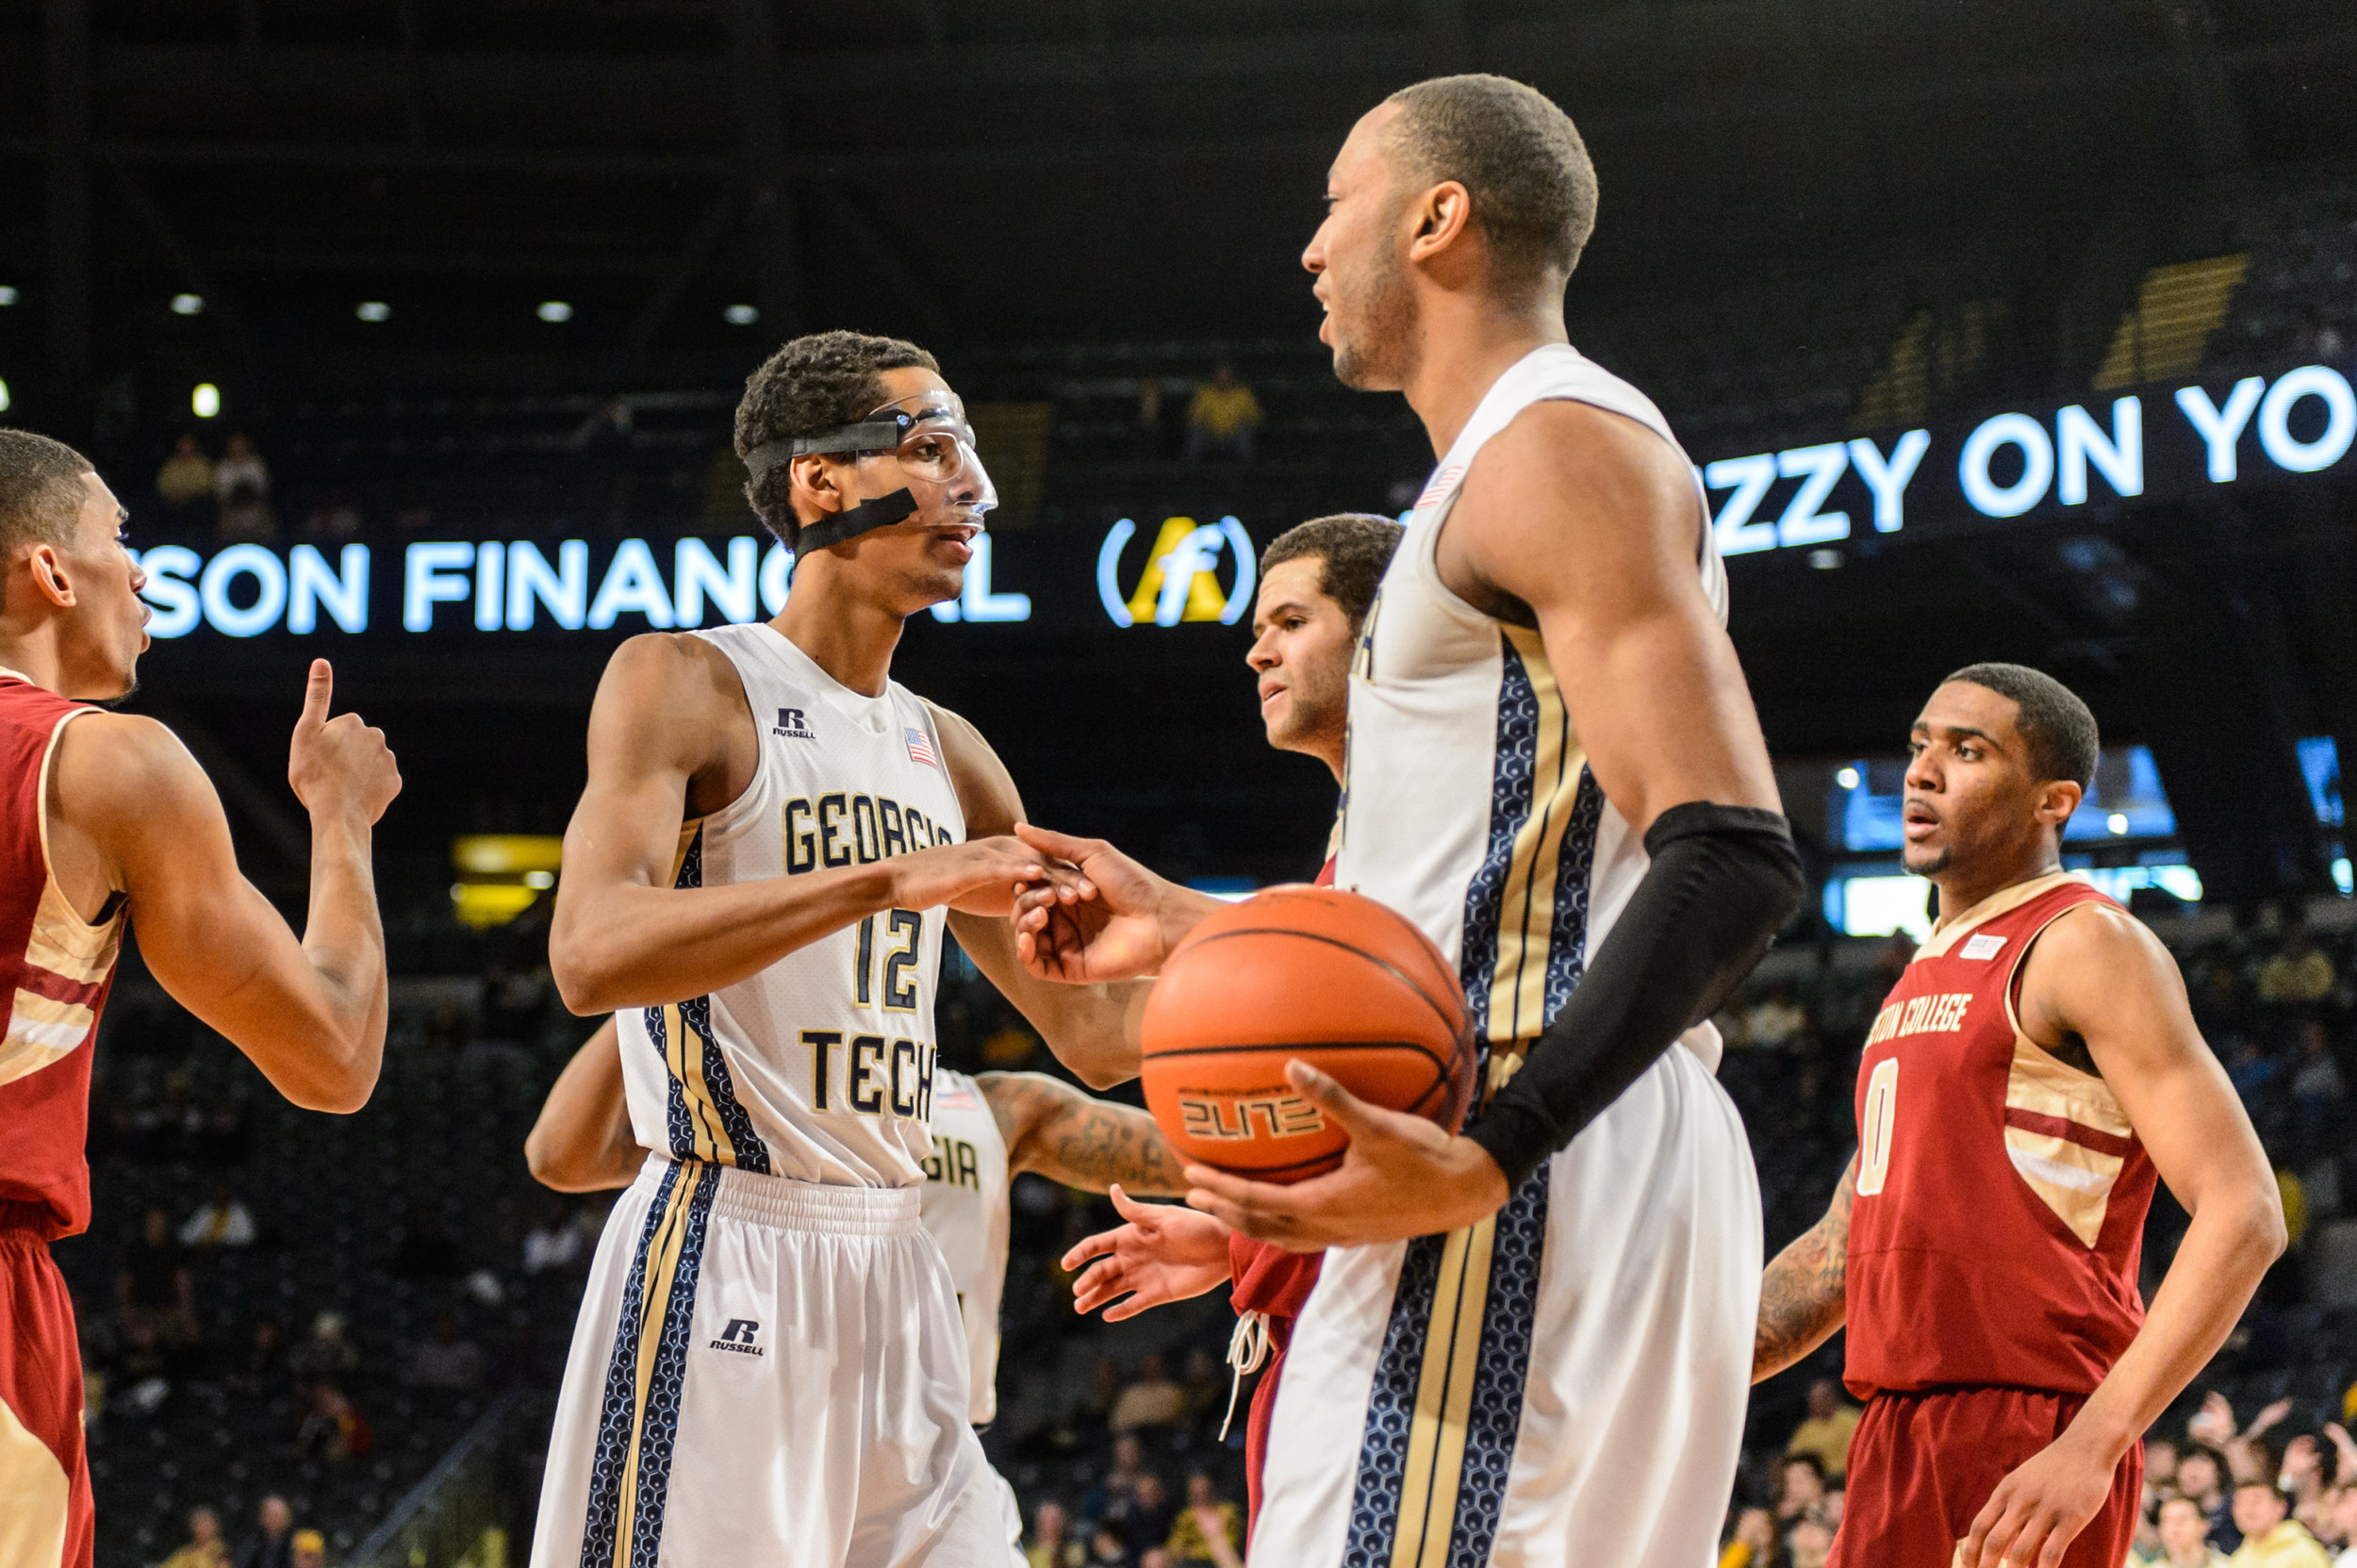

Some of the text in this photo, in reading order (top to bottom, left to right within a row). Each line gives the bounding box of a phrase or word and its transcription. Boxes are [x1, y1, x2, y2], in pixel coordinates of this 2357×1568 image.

[1694, 364, 2357, 556] ZZY ON YO
[127, 531, 1031, 638] SON FINANL
[772, 727, 816, 739] RUSSELL
[853, 907, 924, 1015] 12
[1898, 993, 1973, 1038] COLLEGE
[799, 1029, 938, 1123] TECH
[1856, 1057, 1899, 1197] 0
[710, 1340, 764, 1356] RUSSELL
